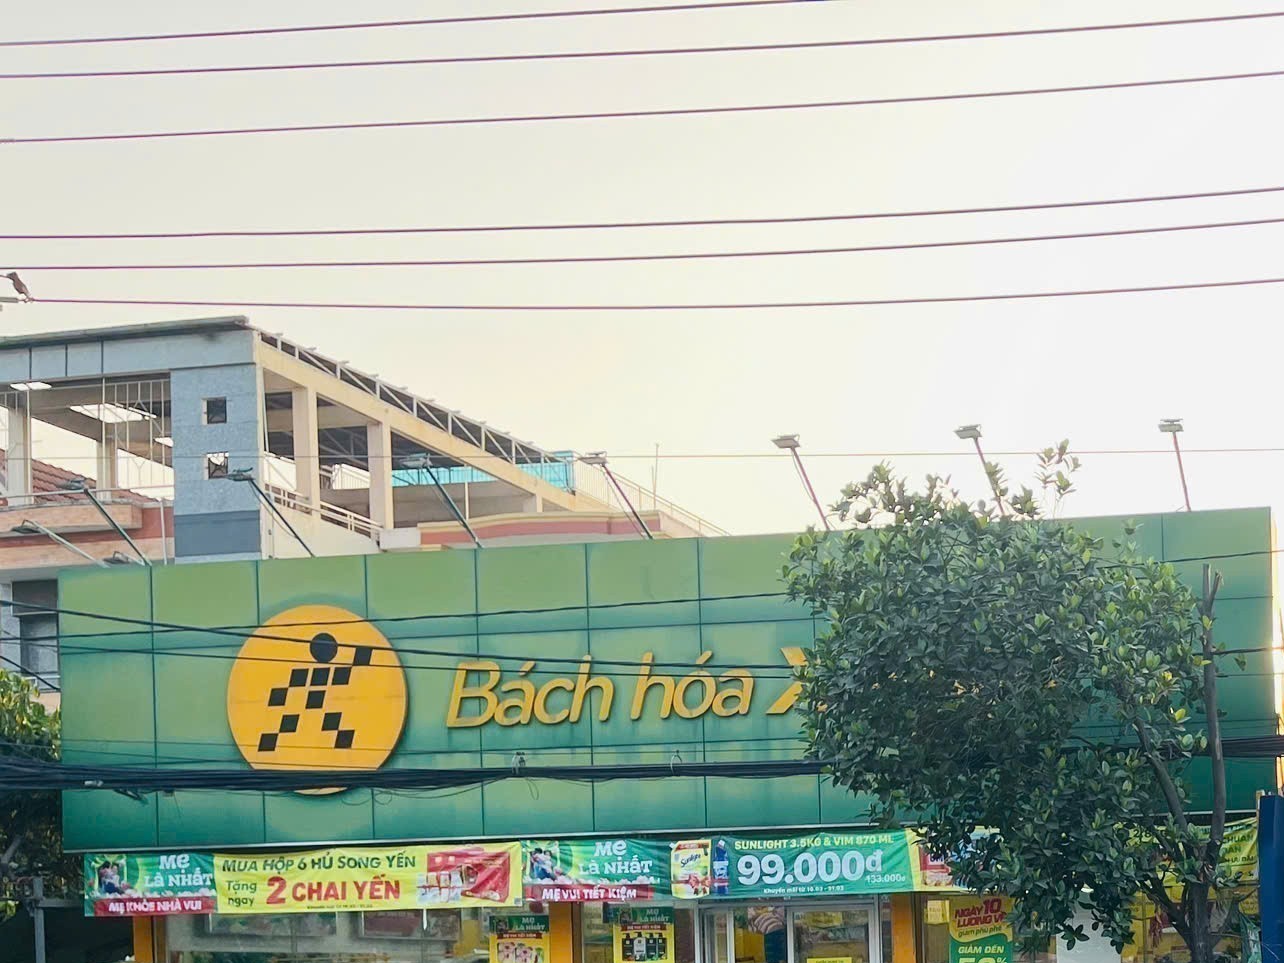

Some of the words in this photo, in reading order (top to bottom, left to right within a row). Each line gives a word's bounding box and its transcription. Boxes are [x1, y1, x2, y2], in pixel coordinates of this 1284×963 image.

[446, 655, 614, 728] Bách
[631, 650, 754, 720] hóa
[735, 839, 788, 851] SUNLIGHT
[824, 836, 831, 847] &
[834, 836, 854, 846] VIM
[856, 835, 875, 846] 870
[878, 835, 895, 845] ML
[222, 859, 258, 872] MUA
[263, 856, 293, 874] HỘP
[298, 857, 306, 870] 6
[311, 851, 333, 870] HỦ
[338, 855, 382, 869] SONG
[386, 850, 416, 868] YẾN
[737, 849, 883, 886] 99.000đ
[226, 880, 257, 895] Tặng
[266, 876, 287, 905] 2
[292, 880, 348, 902] CHAI
[353, 873, 401, 900] YẾN
[562, 889, 580, 900] VUI
[584, 884, 605, 899] TIẾT
[608, 886, 637, 902] KIỆM
[157, 899, 181, 912] NHÀ
[183, 900, 202, 911] VUI
[228, 895, 255, 907] ngay
[983, 897, 1002, 915] 10
[958, 943, 982, 954] GIẢM
